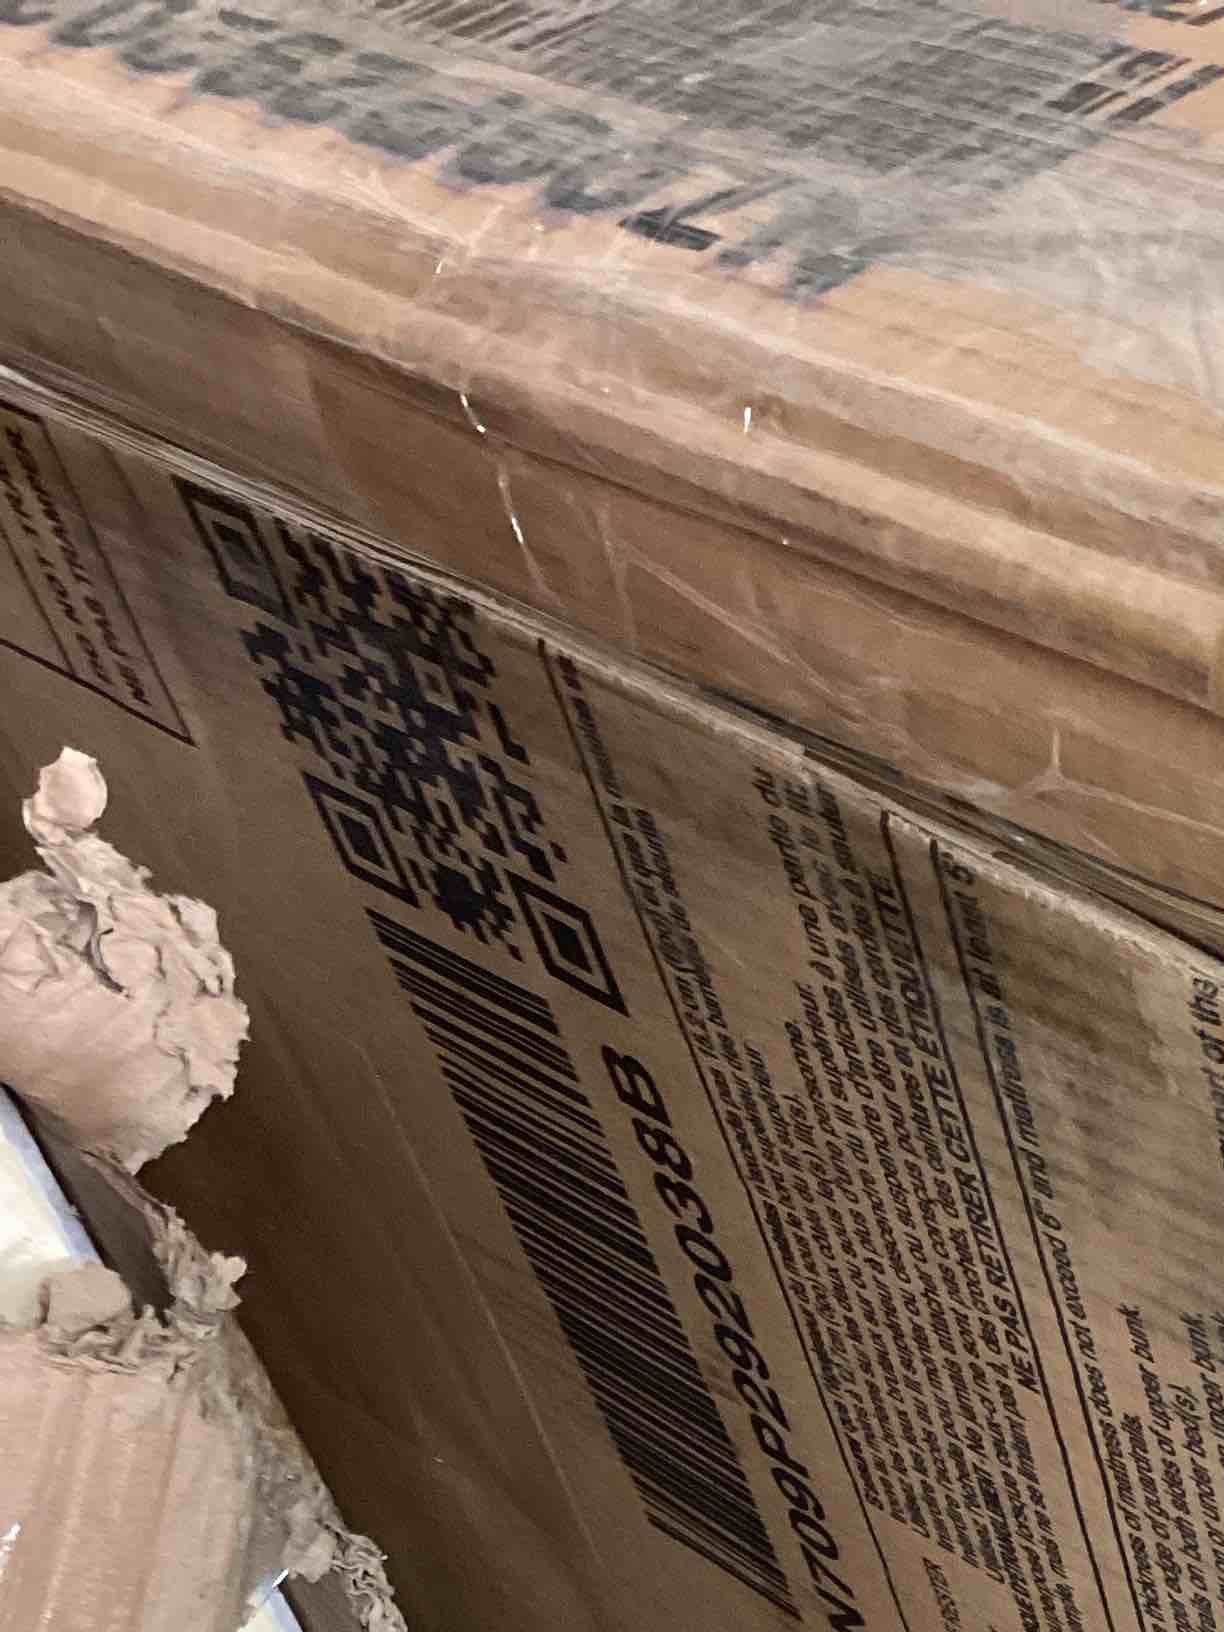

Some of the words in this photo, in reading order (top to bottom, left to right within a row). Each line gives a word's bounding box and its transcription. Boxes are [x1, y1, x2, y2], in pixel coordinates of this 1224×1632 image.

[793, 896, 831, 961] une
[863, 868, 945, 1063] ÉTIQUETTE
[787, 972, 858, 1110] supérieur.
[815, 979, 877, 1105] d'articles
[781, 1013, 844, 1144] personne.
[989, 1030, 1042, 1149] mattress
[830, 1098, 860, 1132] lit
[882, 1091, 924, 1162] pour
[919, 1056, 976, 1171] CETTE
[854, 1097, 924, 1236] suspendre
[927, 1170, 961, 1222] des
[1020, 1145, 1056, 1202] and
[840, 1199, 883, 1261] plus
[851, 1160, 911, 1288] descendre
[951, 1163, 1012, 1297] RETIRER
[853, 1290, 880, 1329] sur
[907, 1258, 957, 1357] attacher
[935, 1258, 969, 1311] pas
[1043, 1230, 1089, 1323] exceed
[901, 1310, 946, 1395] monter
[945, 1300, 980, 1362] sont
[969, 1308, 1002, 1358] des
[988, 1287, 1028, 1355] PAS
[1066, 1317, 1099, 1362] not
[1115, 1295, 1154, 1364] bunk.
[1177, 1302, 1216, 1374] bunk.
[931, 1390, 967, 1448] pour
[993, 1375, 1026, 1423] pas
[1078, 1359, 1114, 1419] does
[1137, 1361, 1176, 1433] upper
[1165, 1374, 1212, 1463] bed(s).
[1093, 1415, 1137, 1509] mattress
[1156, 1454, 1191, 1516] sides
[1184, 1454, 1220, 1523] under
[1150, 1537, 1188, 1598] edge
[1169, 1509, 1202, 1564] both
[1122, 1527, 1166, 1623] thickness
